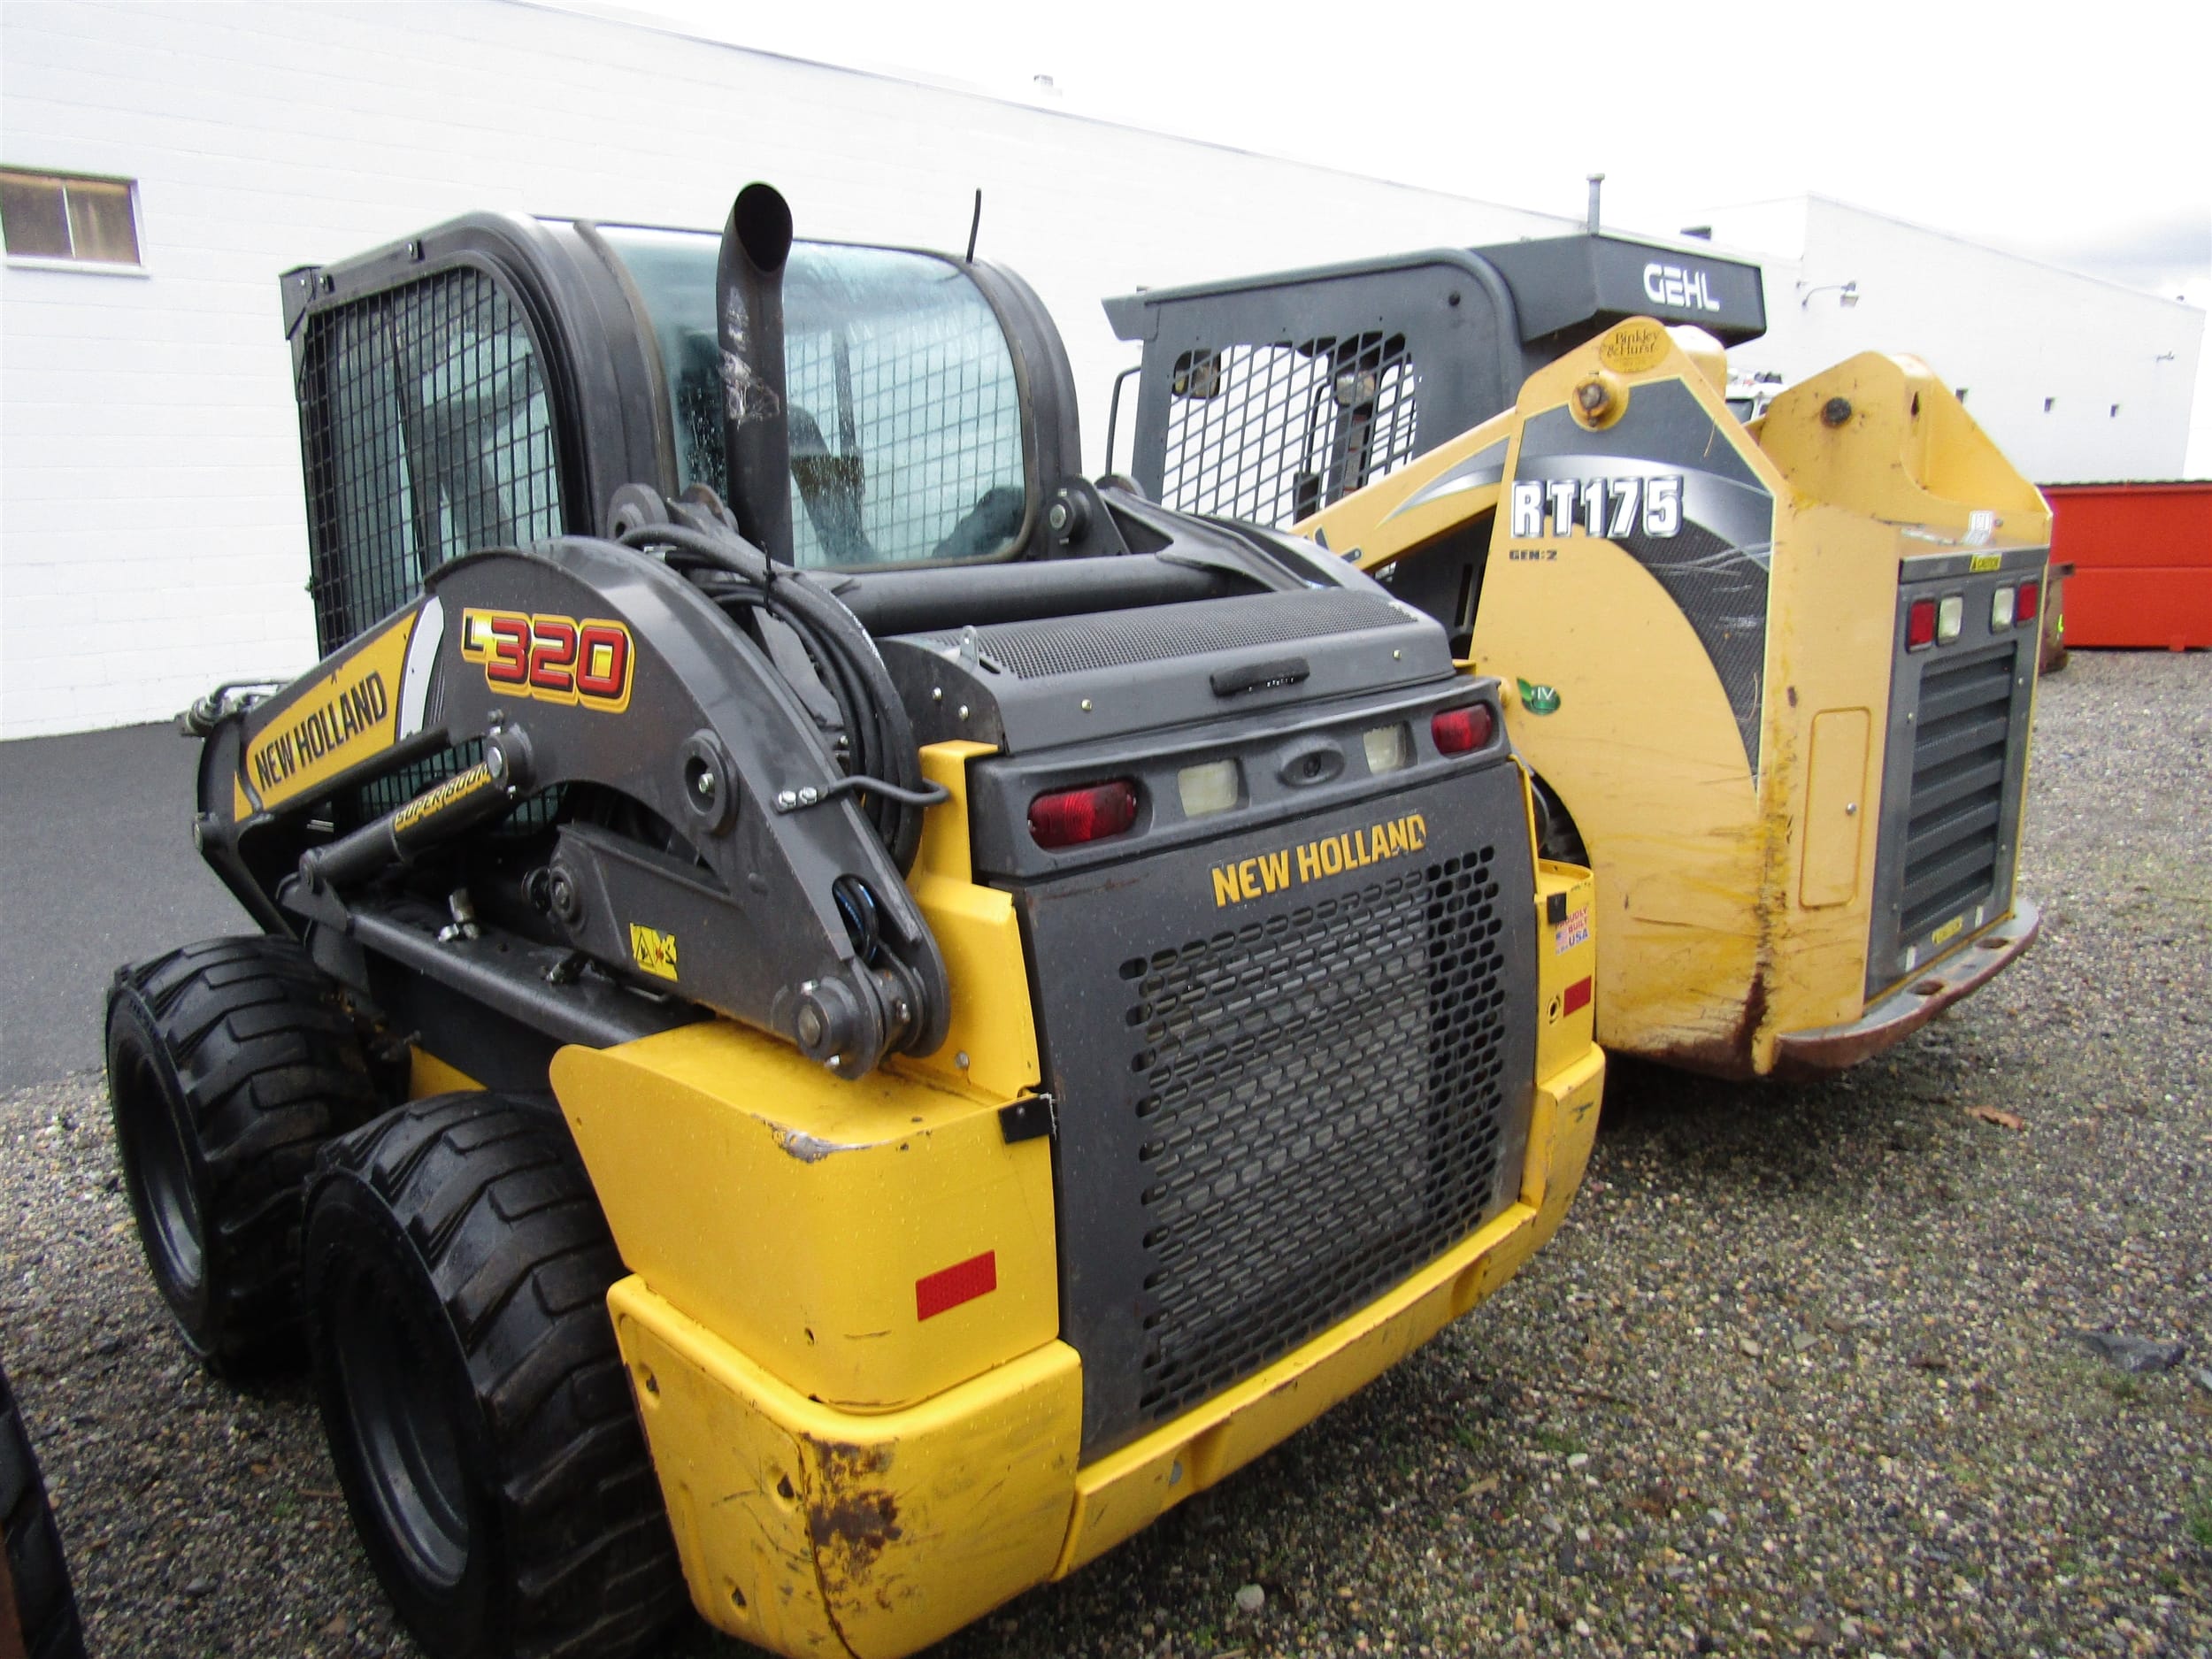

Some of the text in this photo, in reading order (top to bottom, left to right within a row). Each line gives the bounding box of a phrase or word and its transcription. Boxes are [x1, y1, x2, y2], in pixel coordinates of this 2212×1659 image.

[1643, 263, 1720, 312] GEHL
[1615, 328, 1661, 345] Binkley
[1510, 475, 1684, 539] RT175
[462, 609, 632, 708] L320
[254, 670, 388, 792] NEW HOLLAND
[395, 764, 491, 830] SUPER BOOM
[1211, 813, 1427, 908] NEW HOLLAND
[1568, 916, 1588, 934] BUILT
[1569, 927, 1589, 947] USA
